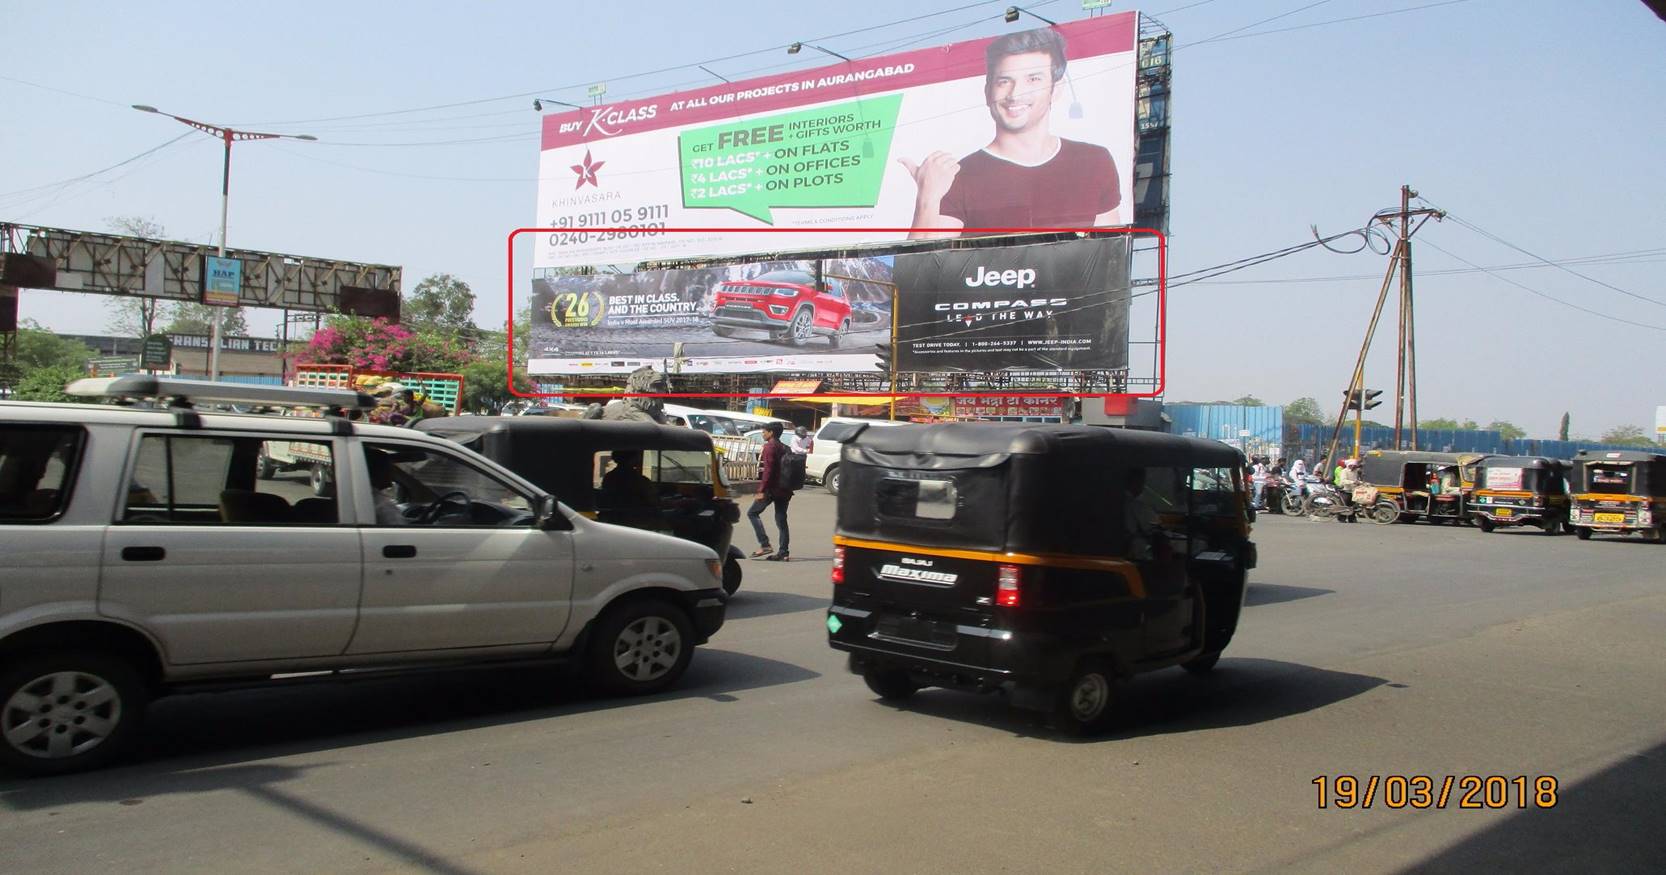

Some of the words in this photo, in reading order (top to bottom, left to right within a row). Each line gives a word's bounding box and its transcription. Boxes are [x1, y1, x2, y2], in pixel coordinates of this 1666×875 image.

[670, 101, 684, 111] AT
[686, 99, 707, 109] ALL
[709, 93, 735, 104] OUR
[737, 82, 799, 101] PROJECTS
[801, 80, 815, 90] IN
[817, 63, 915, 88] AURANGABAD
[560, 121, 582, 133] BUY
[692, 143, 714, 153] GET
[718, 124, 784, 150] FREE
[789, 113, 854, 130] INTERIORS
[796, 126, 830, 139] GIFTS
[833, 120, 881, 135] WORTH
[774, 147, 798, 159] ON
[802, 140, 850, 156] FLATS
[766, 163, 789, 175] ON
[794, 155, 861, 173] OFFICES
[766, 179, 789, 191] ON
[793, 173, 844, 188] PLOTS
[551, 191, 621, 208] KHINVASARA
[550, 216, 574, 229] +91
[578, 211, 606, 228] 9111
[611, 208, 632, 224] 05
[637, 204, 669, 221] 9111
[549, 222, 665, 247] 0240-2980101
[966, 266, 1036, 288] Jeep
[565, 292, 589, 317] 26
[608, 295, 634, 305] BEST
[634, 294, 645, 304] IN
[646, 293, 680, 304] CLASS.
[935, 298, 1067, 311] COMPASS
[608, 305, 628, 315] AND
[630, 304, 648, 314] THE
[992, 311, 1016, 321] THE
[1024, 310, 1053, 320] WAY
